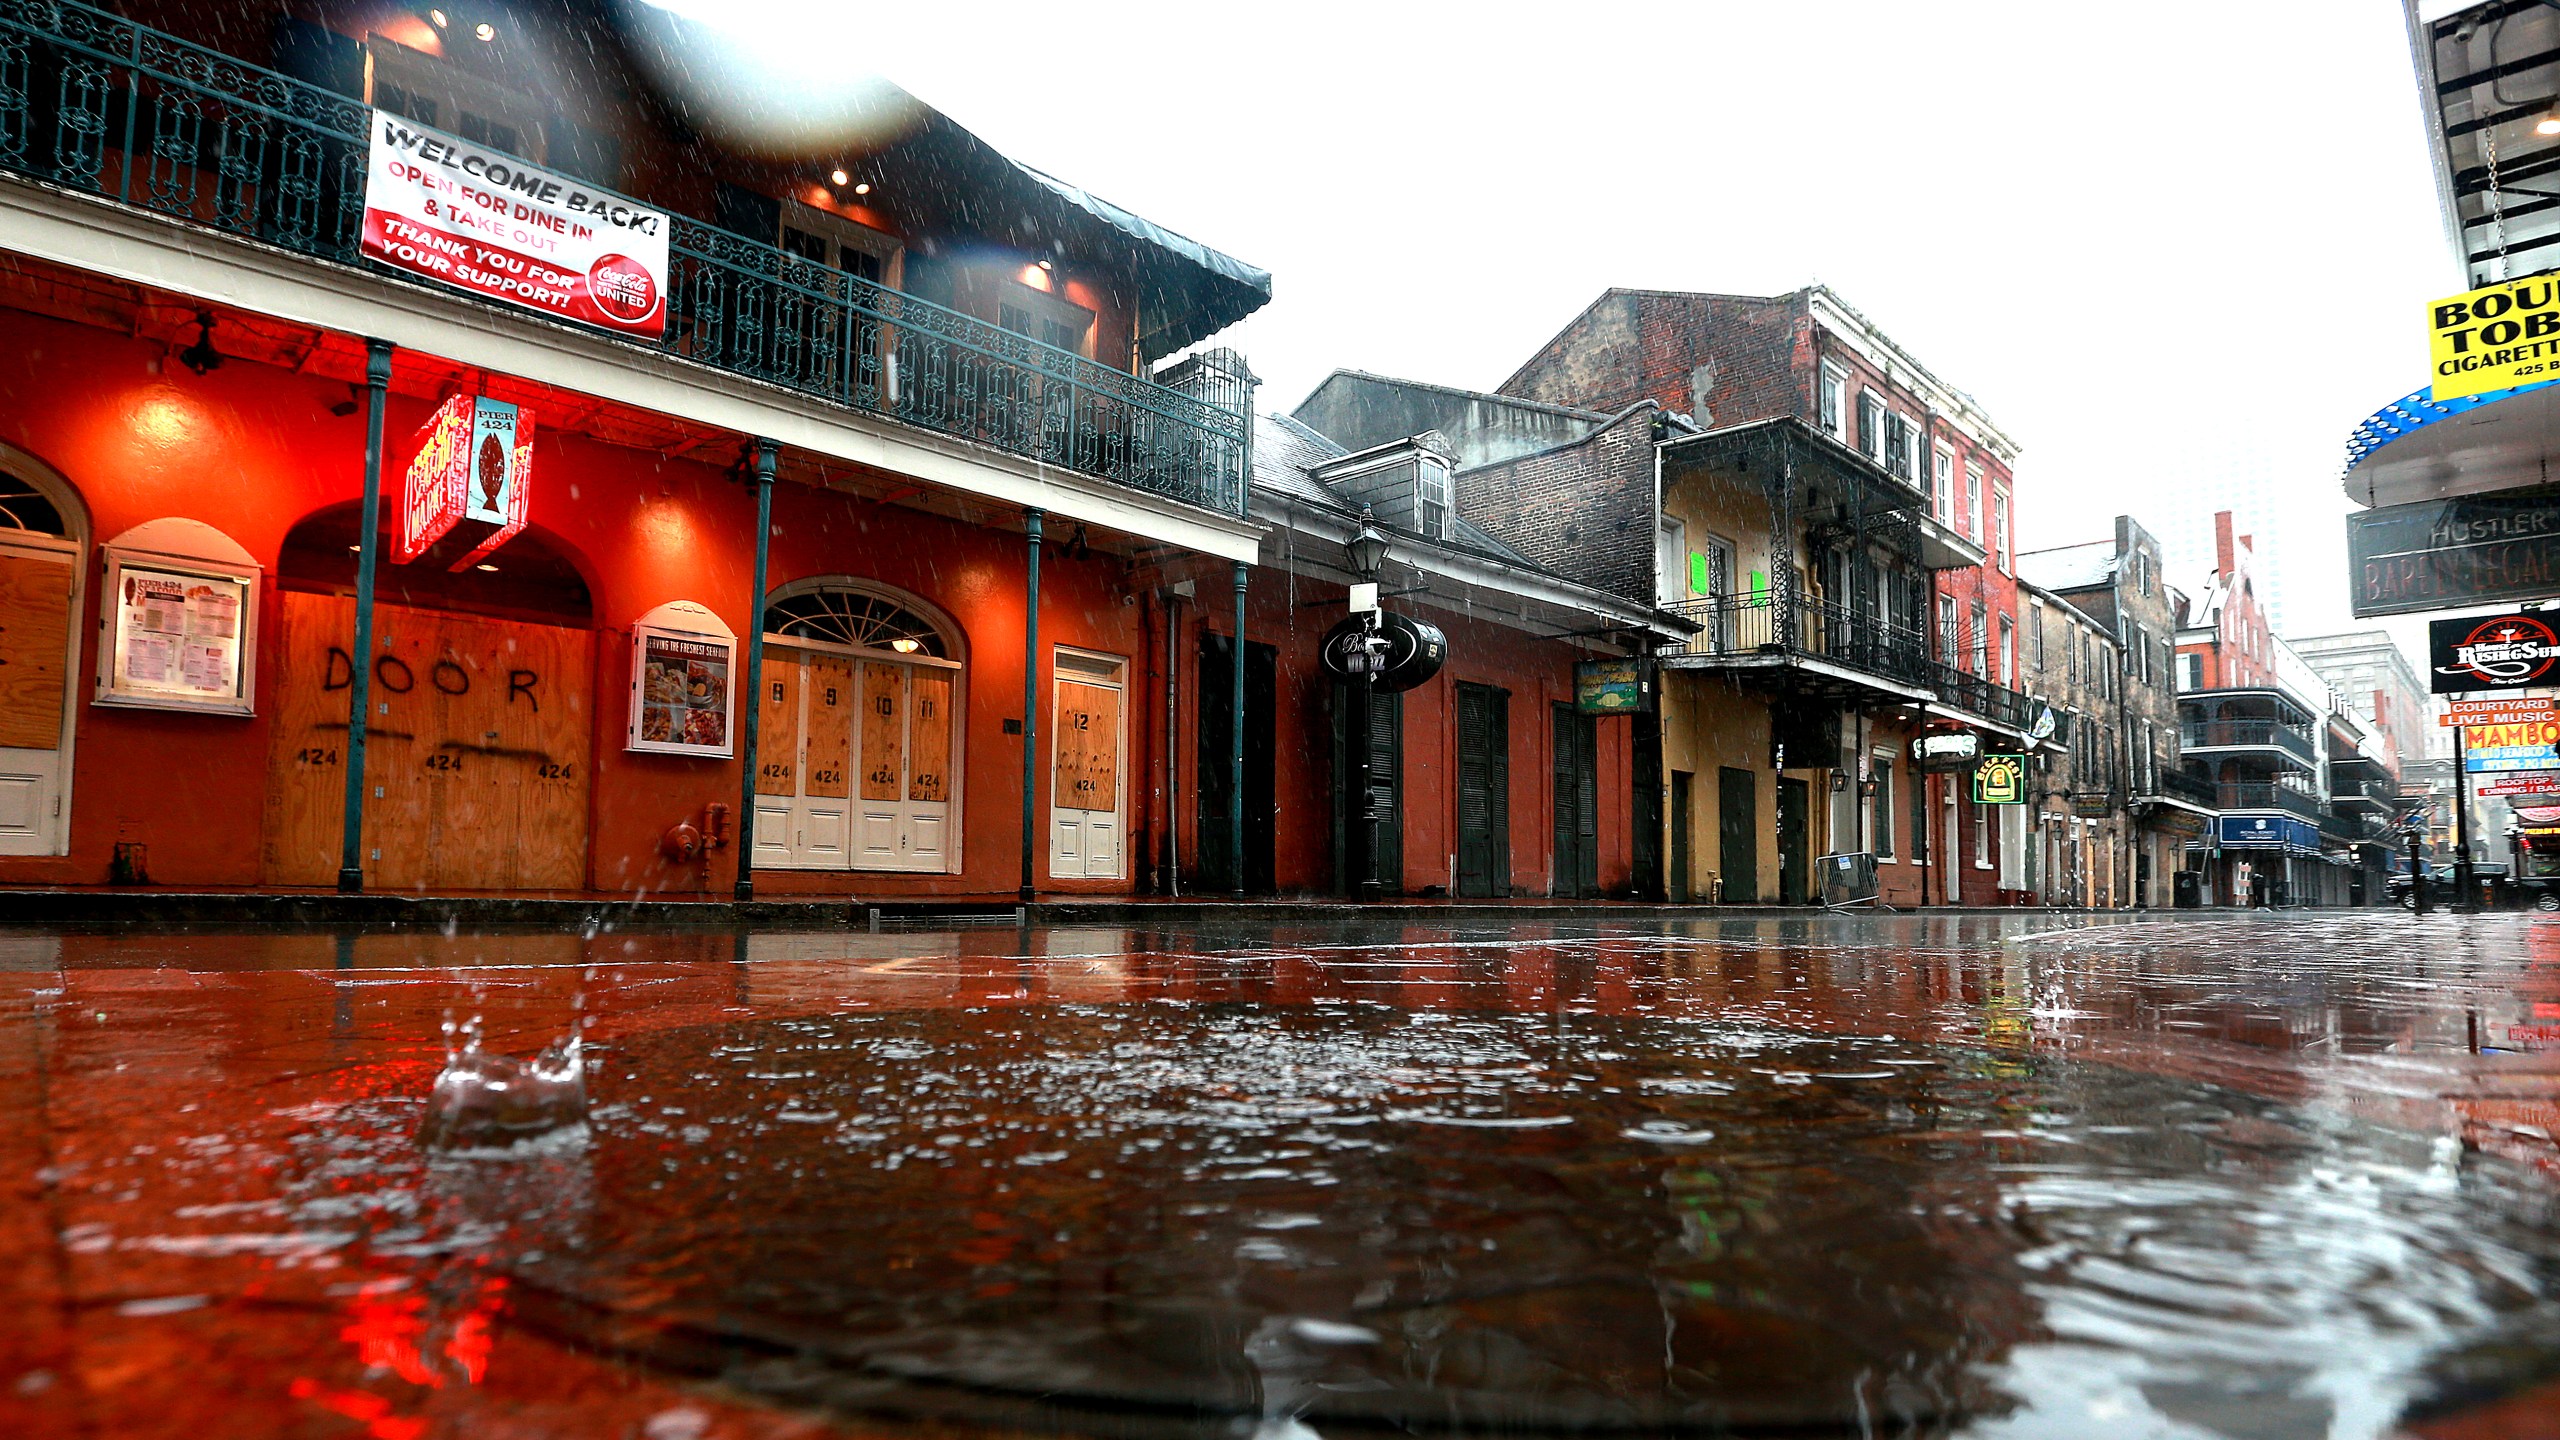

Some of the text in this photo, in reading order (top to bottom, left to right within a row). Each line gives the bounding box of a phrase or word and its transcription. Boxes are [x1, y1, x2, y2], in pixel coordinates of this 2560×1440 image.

[385, 121, 660, 236] WELCOME BACK!
[388, 161, 593, 242] OPEN FOR DINE IN
[424, 198, 558, 253] & TAKE OUT
[384, 218, 575, 290] THANK YOU FOR
[382, 239, 571, 308] YOUR SUPPORT!
[596, 286, 647, 308] UNITED
[2435, 281, 2560, 329] BOU
[2442, 311, 2560, 354] TOB
[2513, 363, 2544, 377] 425
[478, 410, 514, 420] PIER
[481, 419, 513, 430] 424
[2430, 511, 2548, 544] HUSTLER
[2364, 542, 2556, 601] BARELY LEGAL
[162, 581, 182, 589] 424
[646, 639, 728, 659] SERVING THE FRESHEST SEAFOOD
[324, 647, 538, 713] DOOR
[771, 682, 784, 702] 8
[826, 688, 837, 706] 9
[875, 696, 892, 716] 10
[920, 698, 934, 718] 11
[2452, 699, 2549, 713] COURTYARD
[1073, 713, 1089, 731] 12
[2447, 711, 2555, 725] LIVE MUSIC
[298, 749, 337, 765] 424
[426, 754, 462, 771] 424
[538, 764, 572, 779] 424
[763, 764, 789, 778] 424
[815, 770, 840, 784] 424
[871, 771, 894, 784] 424
[1976, 757, 2022, 780] BEER FEST
[917, 773, 940, 787] 424
[1076, 780, 1096, 791] 424
[2496, 777, 2550, 787] ROOFTOP
